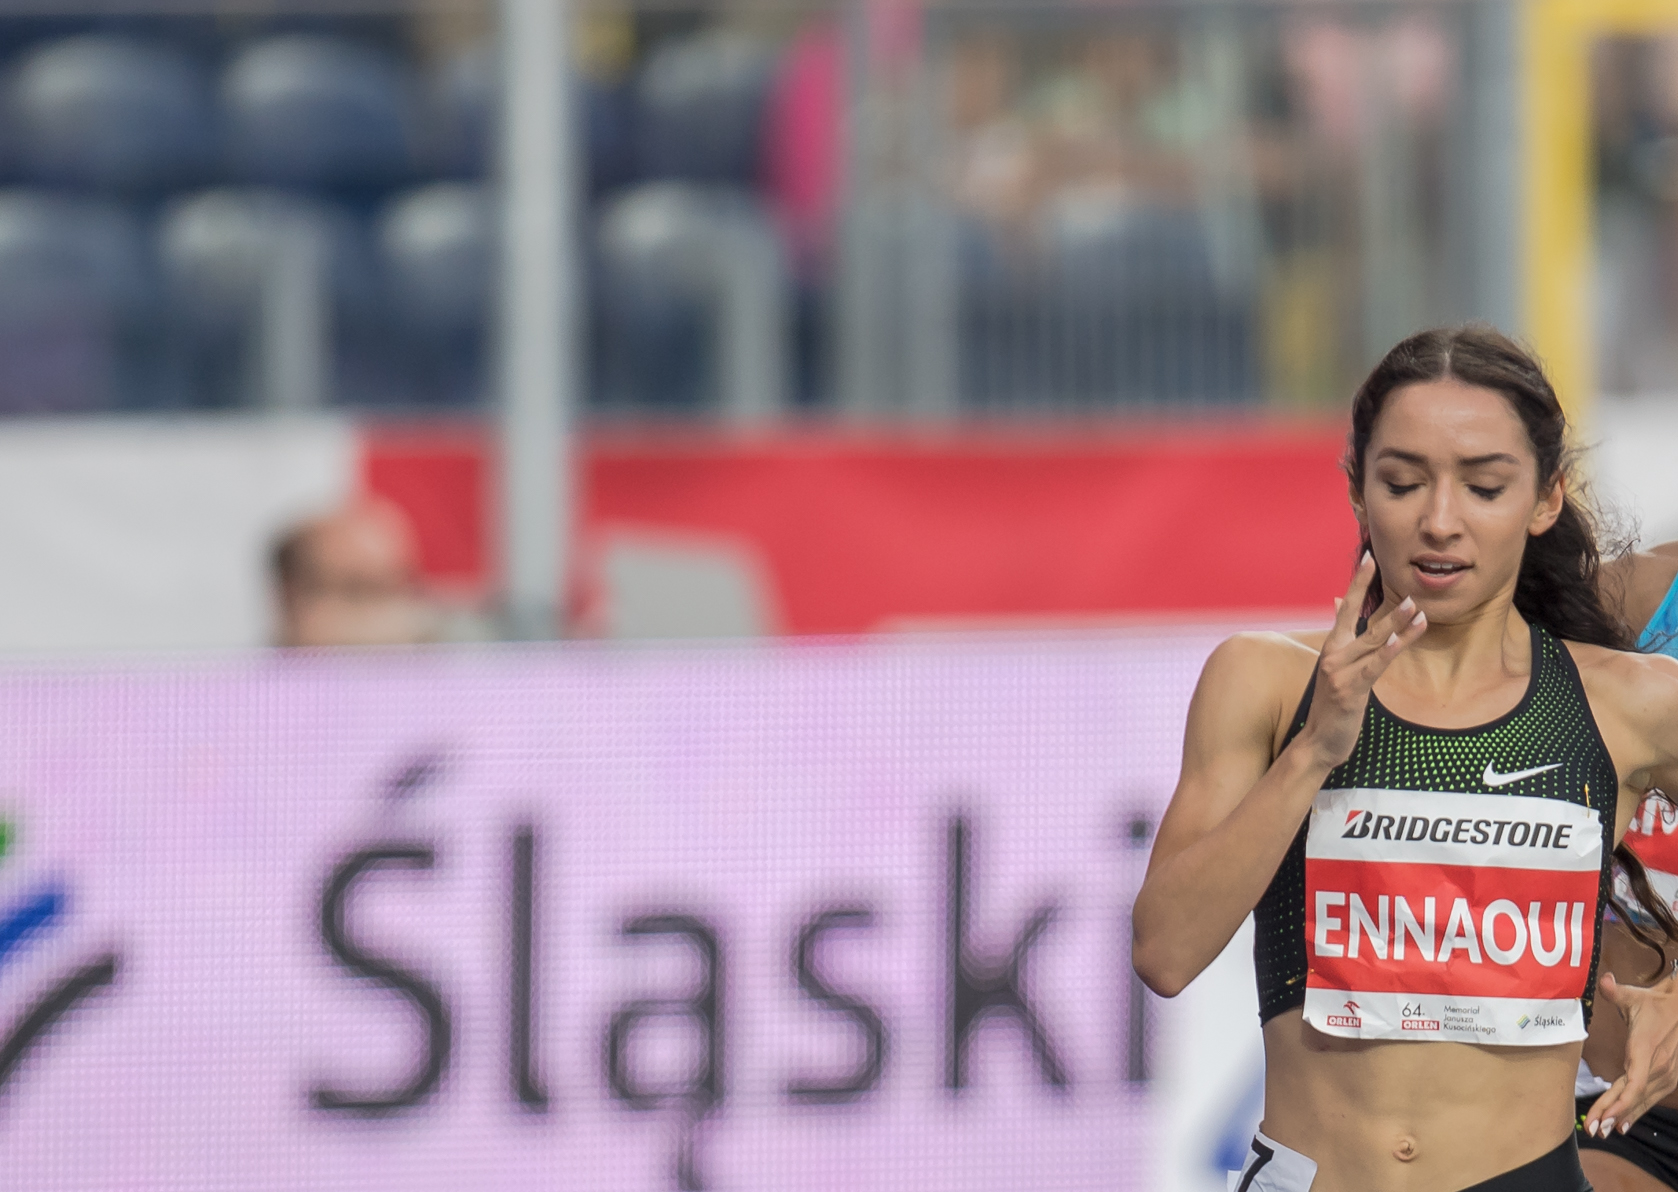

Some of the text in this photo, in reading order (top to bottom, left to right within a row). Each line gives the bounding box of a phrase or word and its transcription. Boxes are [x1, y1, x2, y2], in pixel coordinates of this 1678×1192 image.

[1342, 810, 1573, 849] BRIDGESTONE
[1314, 890, 1585, 968] ENNAOUI
[1328, 1016, 1360, 1027] ORLEN
[1403, 1021, 1438, 1030] ORLEN
